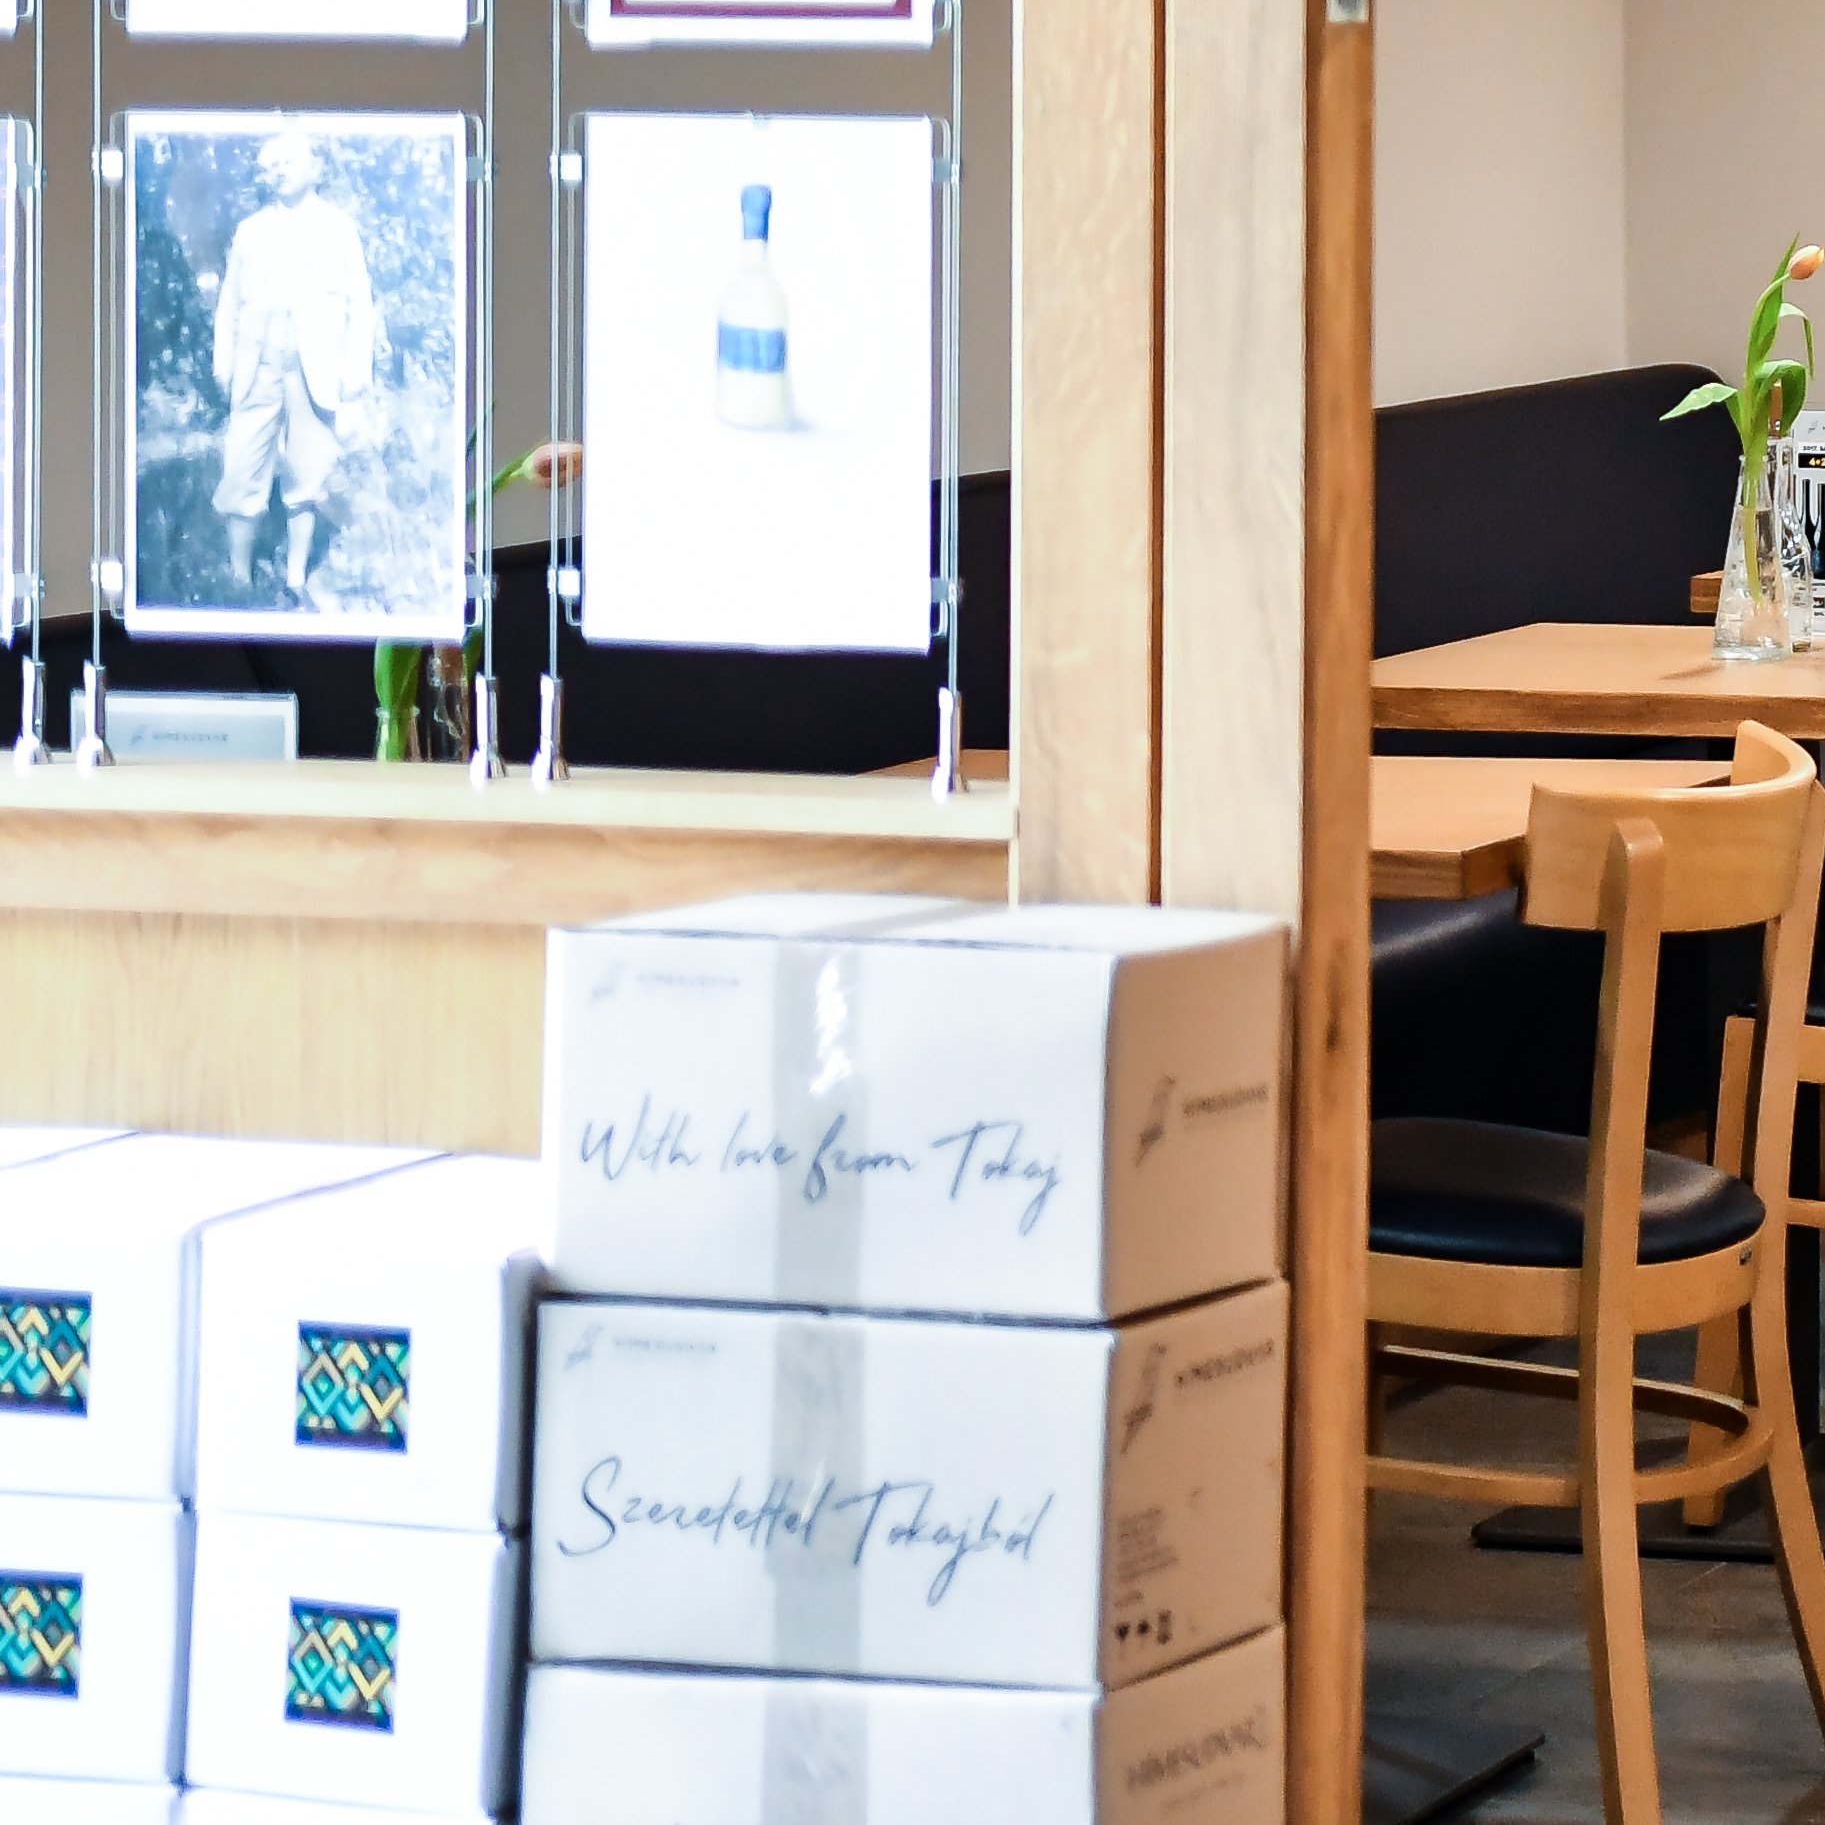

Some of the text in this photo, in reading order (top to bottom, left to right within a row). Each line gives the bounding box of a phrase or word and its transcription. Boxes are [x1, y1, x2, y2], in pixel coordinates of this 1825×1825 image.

[581, 1091, 1061, 1237] With love from Tokaj
[556, 1455, 836, 1558] Szeretettel
